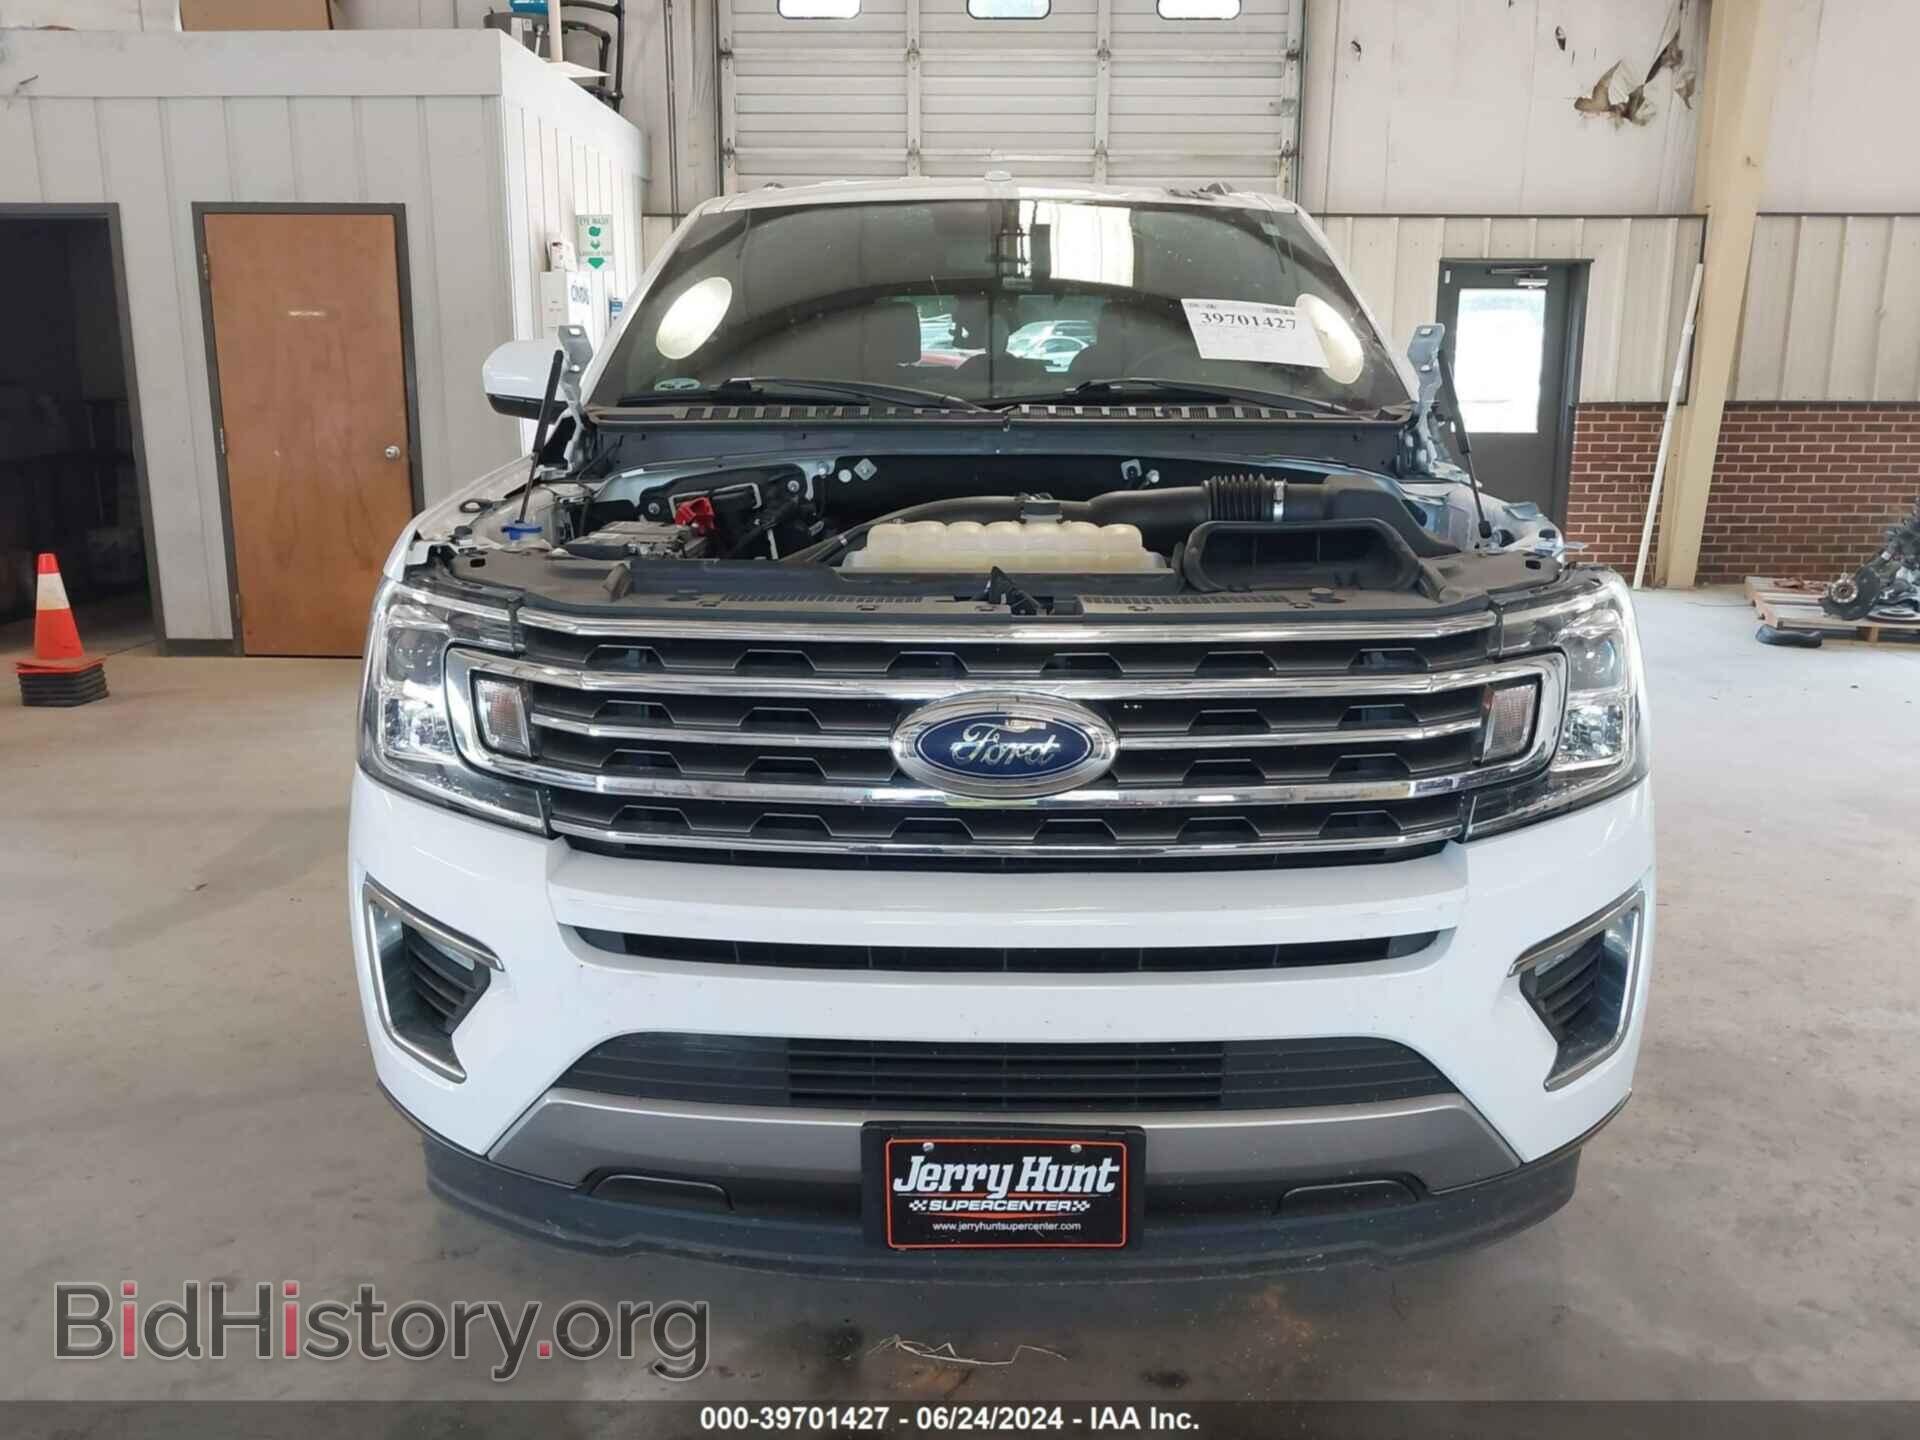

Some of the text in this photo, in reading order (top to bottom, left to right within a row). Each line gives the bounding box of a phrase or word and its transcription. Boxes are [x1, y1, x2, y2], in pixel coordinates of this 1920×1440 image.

[1200, 312, 1296, 330] 39701427
[949, 722, 1059, 765] Ford
[893, 1155, 1120, 1199] Jerry Hunt
[929, 1200, 1072, 1212] SUPERCENTER
[932, 1221, 1082, 1233] www.jerryhuntsupercenter.com
